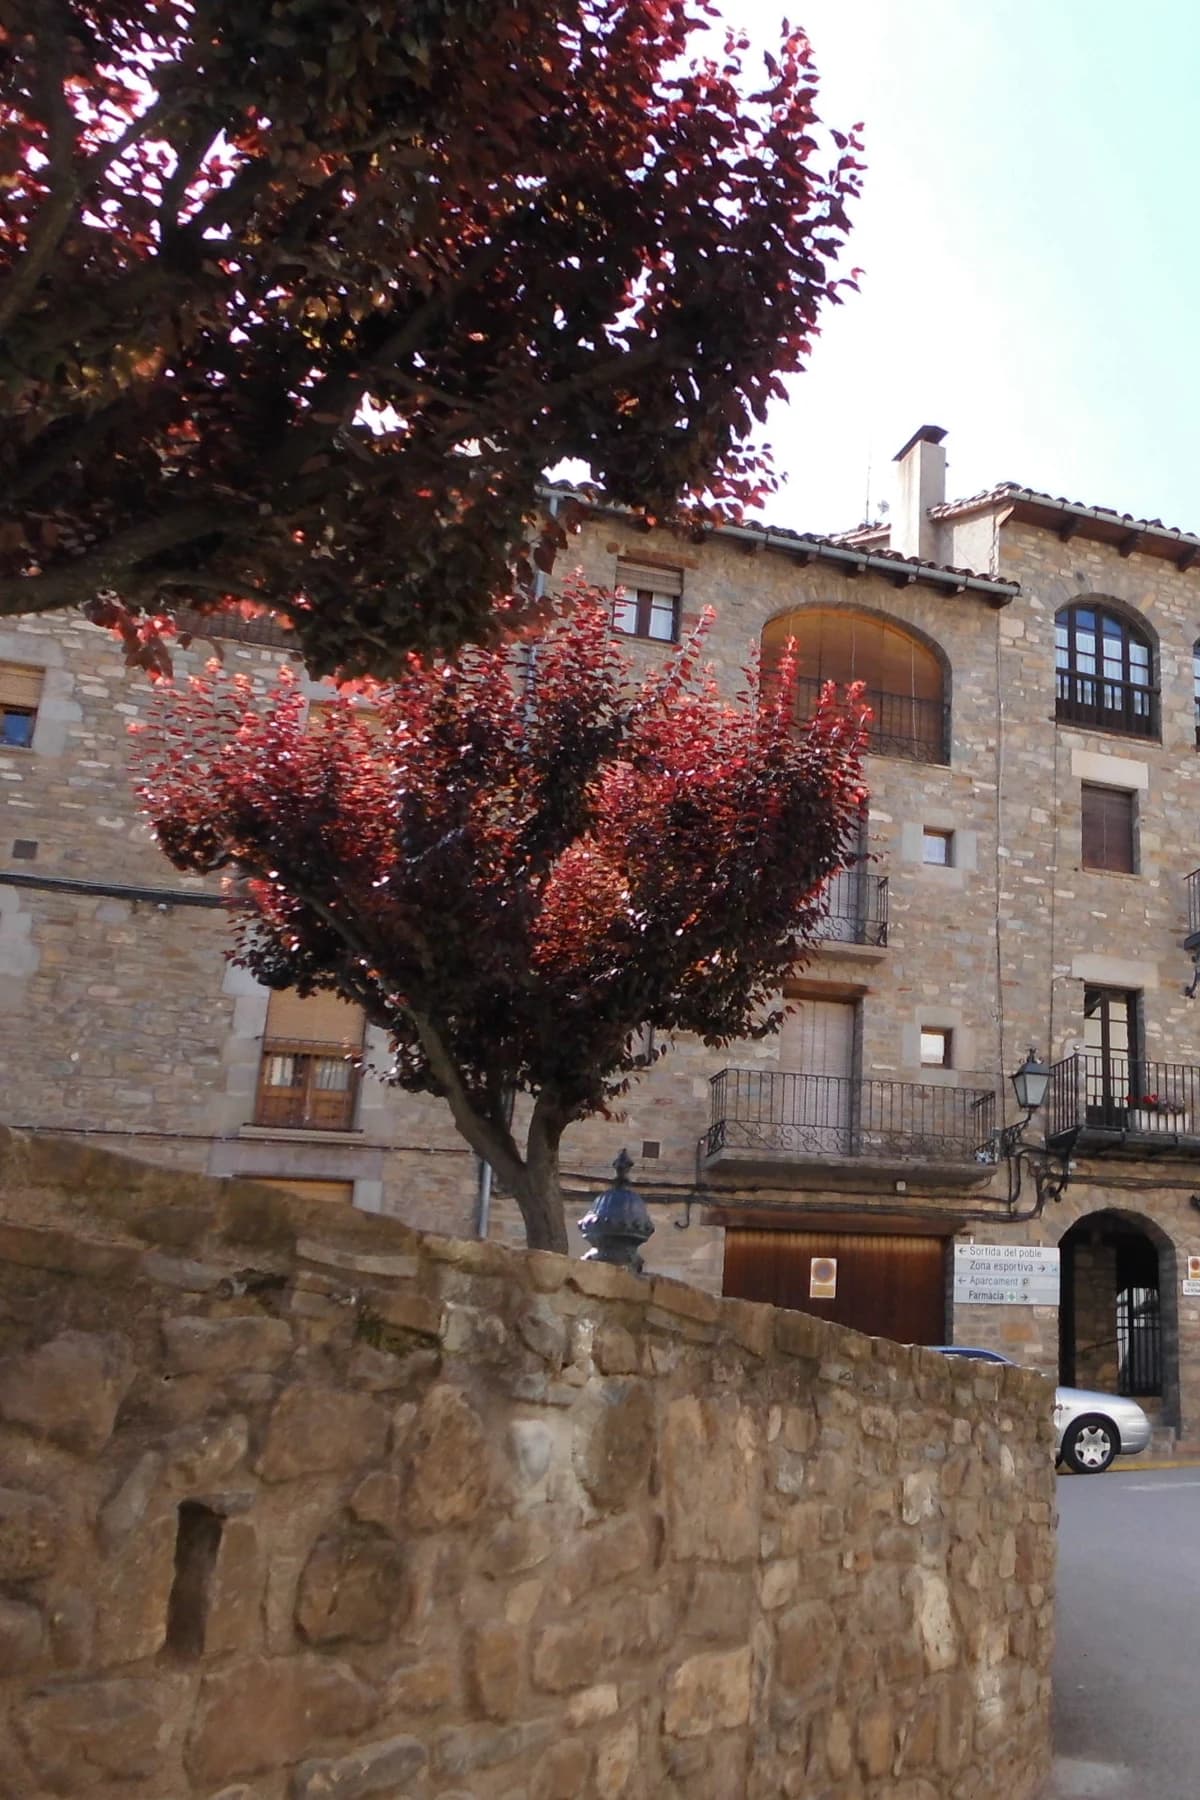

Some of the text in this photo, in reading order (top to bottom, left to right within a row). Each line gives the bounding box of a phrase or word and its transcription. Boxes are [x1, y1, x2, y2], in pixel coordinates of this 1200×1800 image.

[969, 1247, 1042, 1258] Sortida del poble
[969, 1261, 1034, 1272] Zona esportiva
[969, 1276, 1018, 1286] Aparcament
